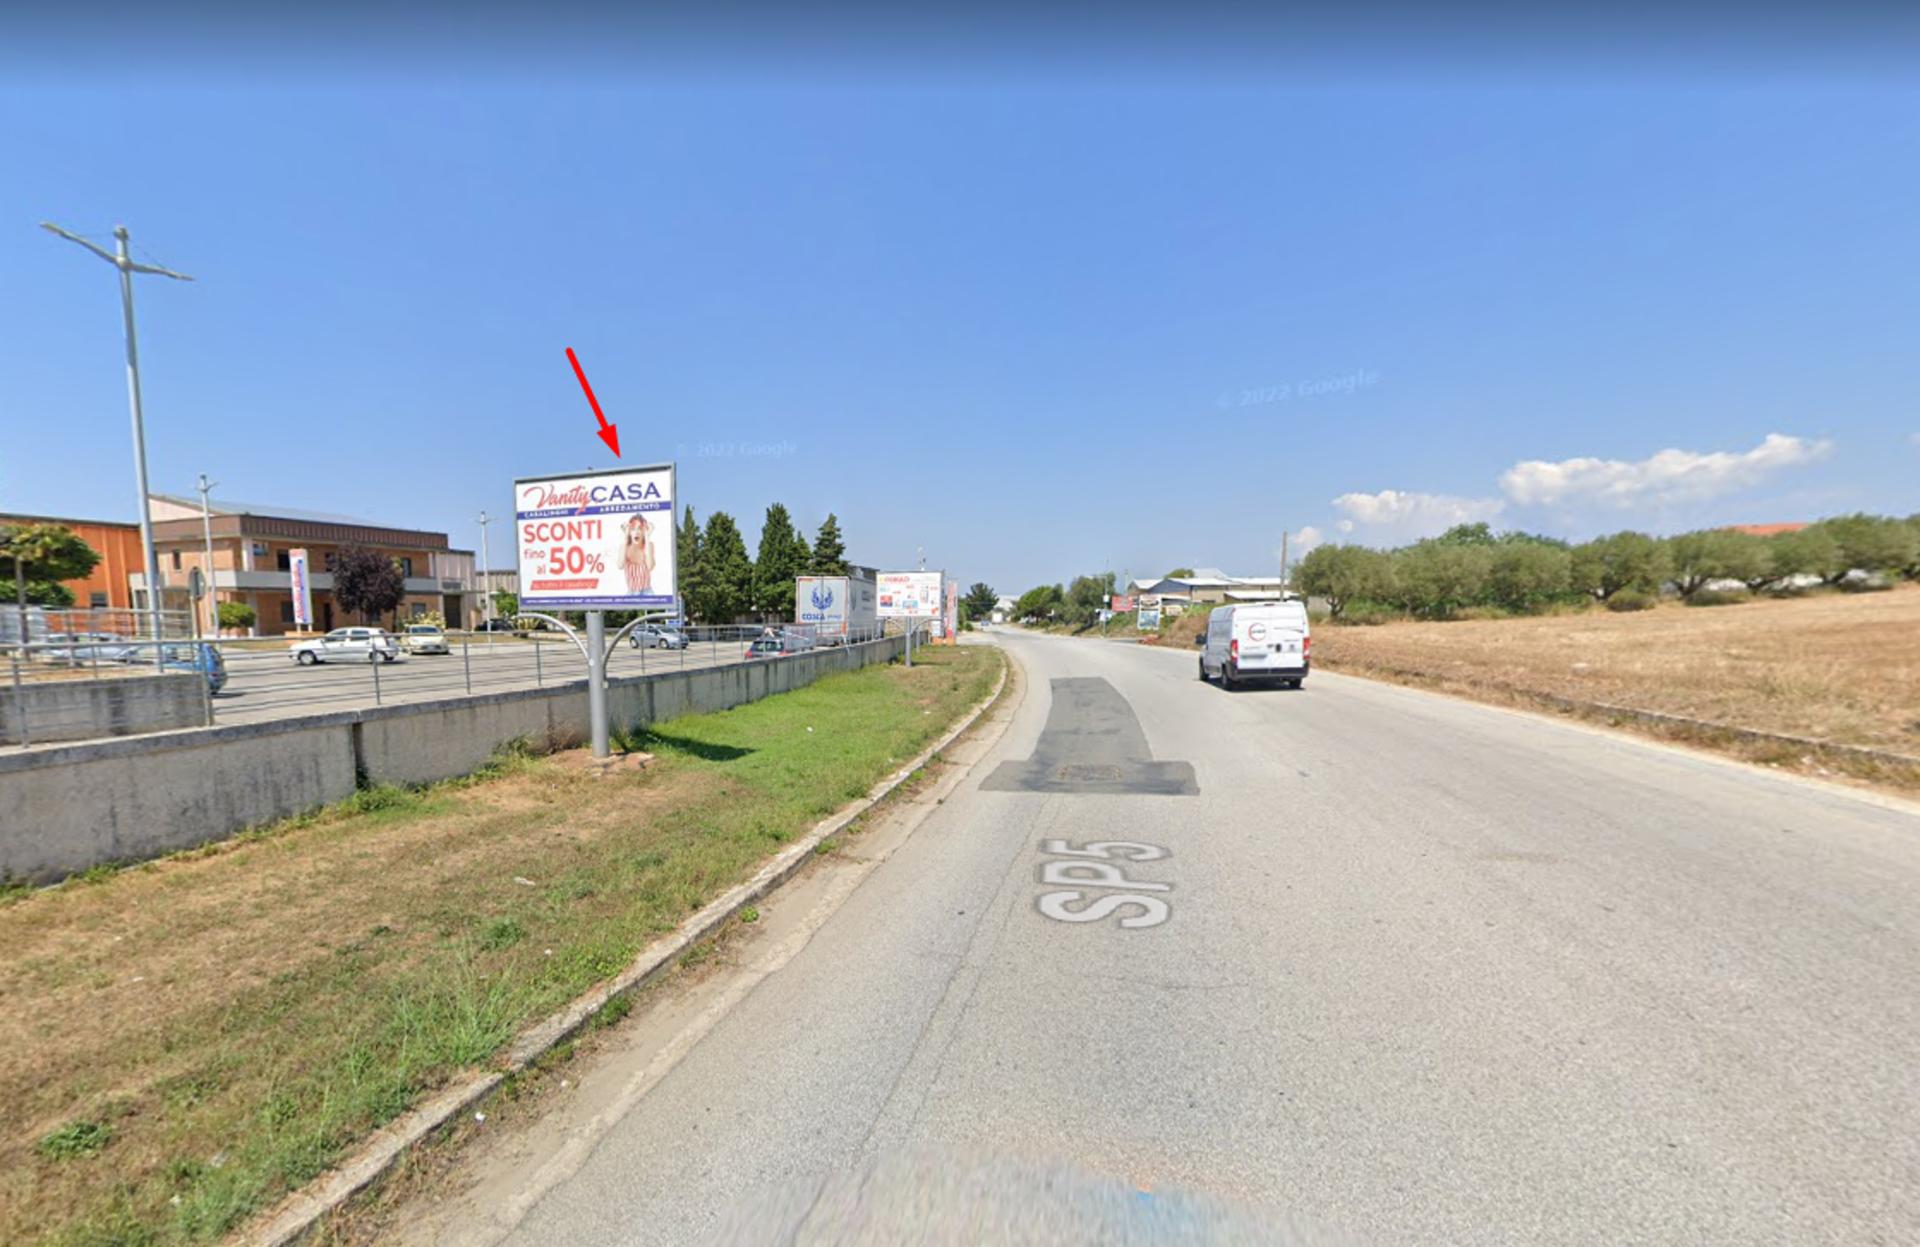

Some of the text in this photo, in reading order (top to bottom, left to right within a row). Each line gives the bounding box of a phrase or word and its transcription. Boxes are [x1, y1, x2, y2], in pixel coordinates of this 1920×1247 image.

[523, 520, 602, 543] SCONTI
[524, 549, 546, 559] fino
[536, 546, 605, 575] al 50%
